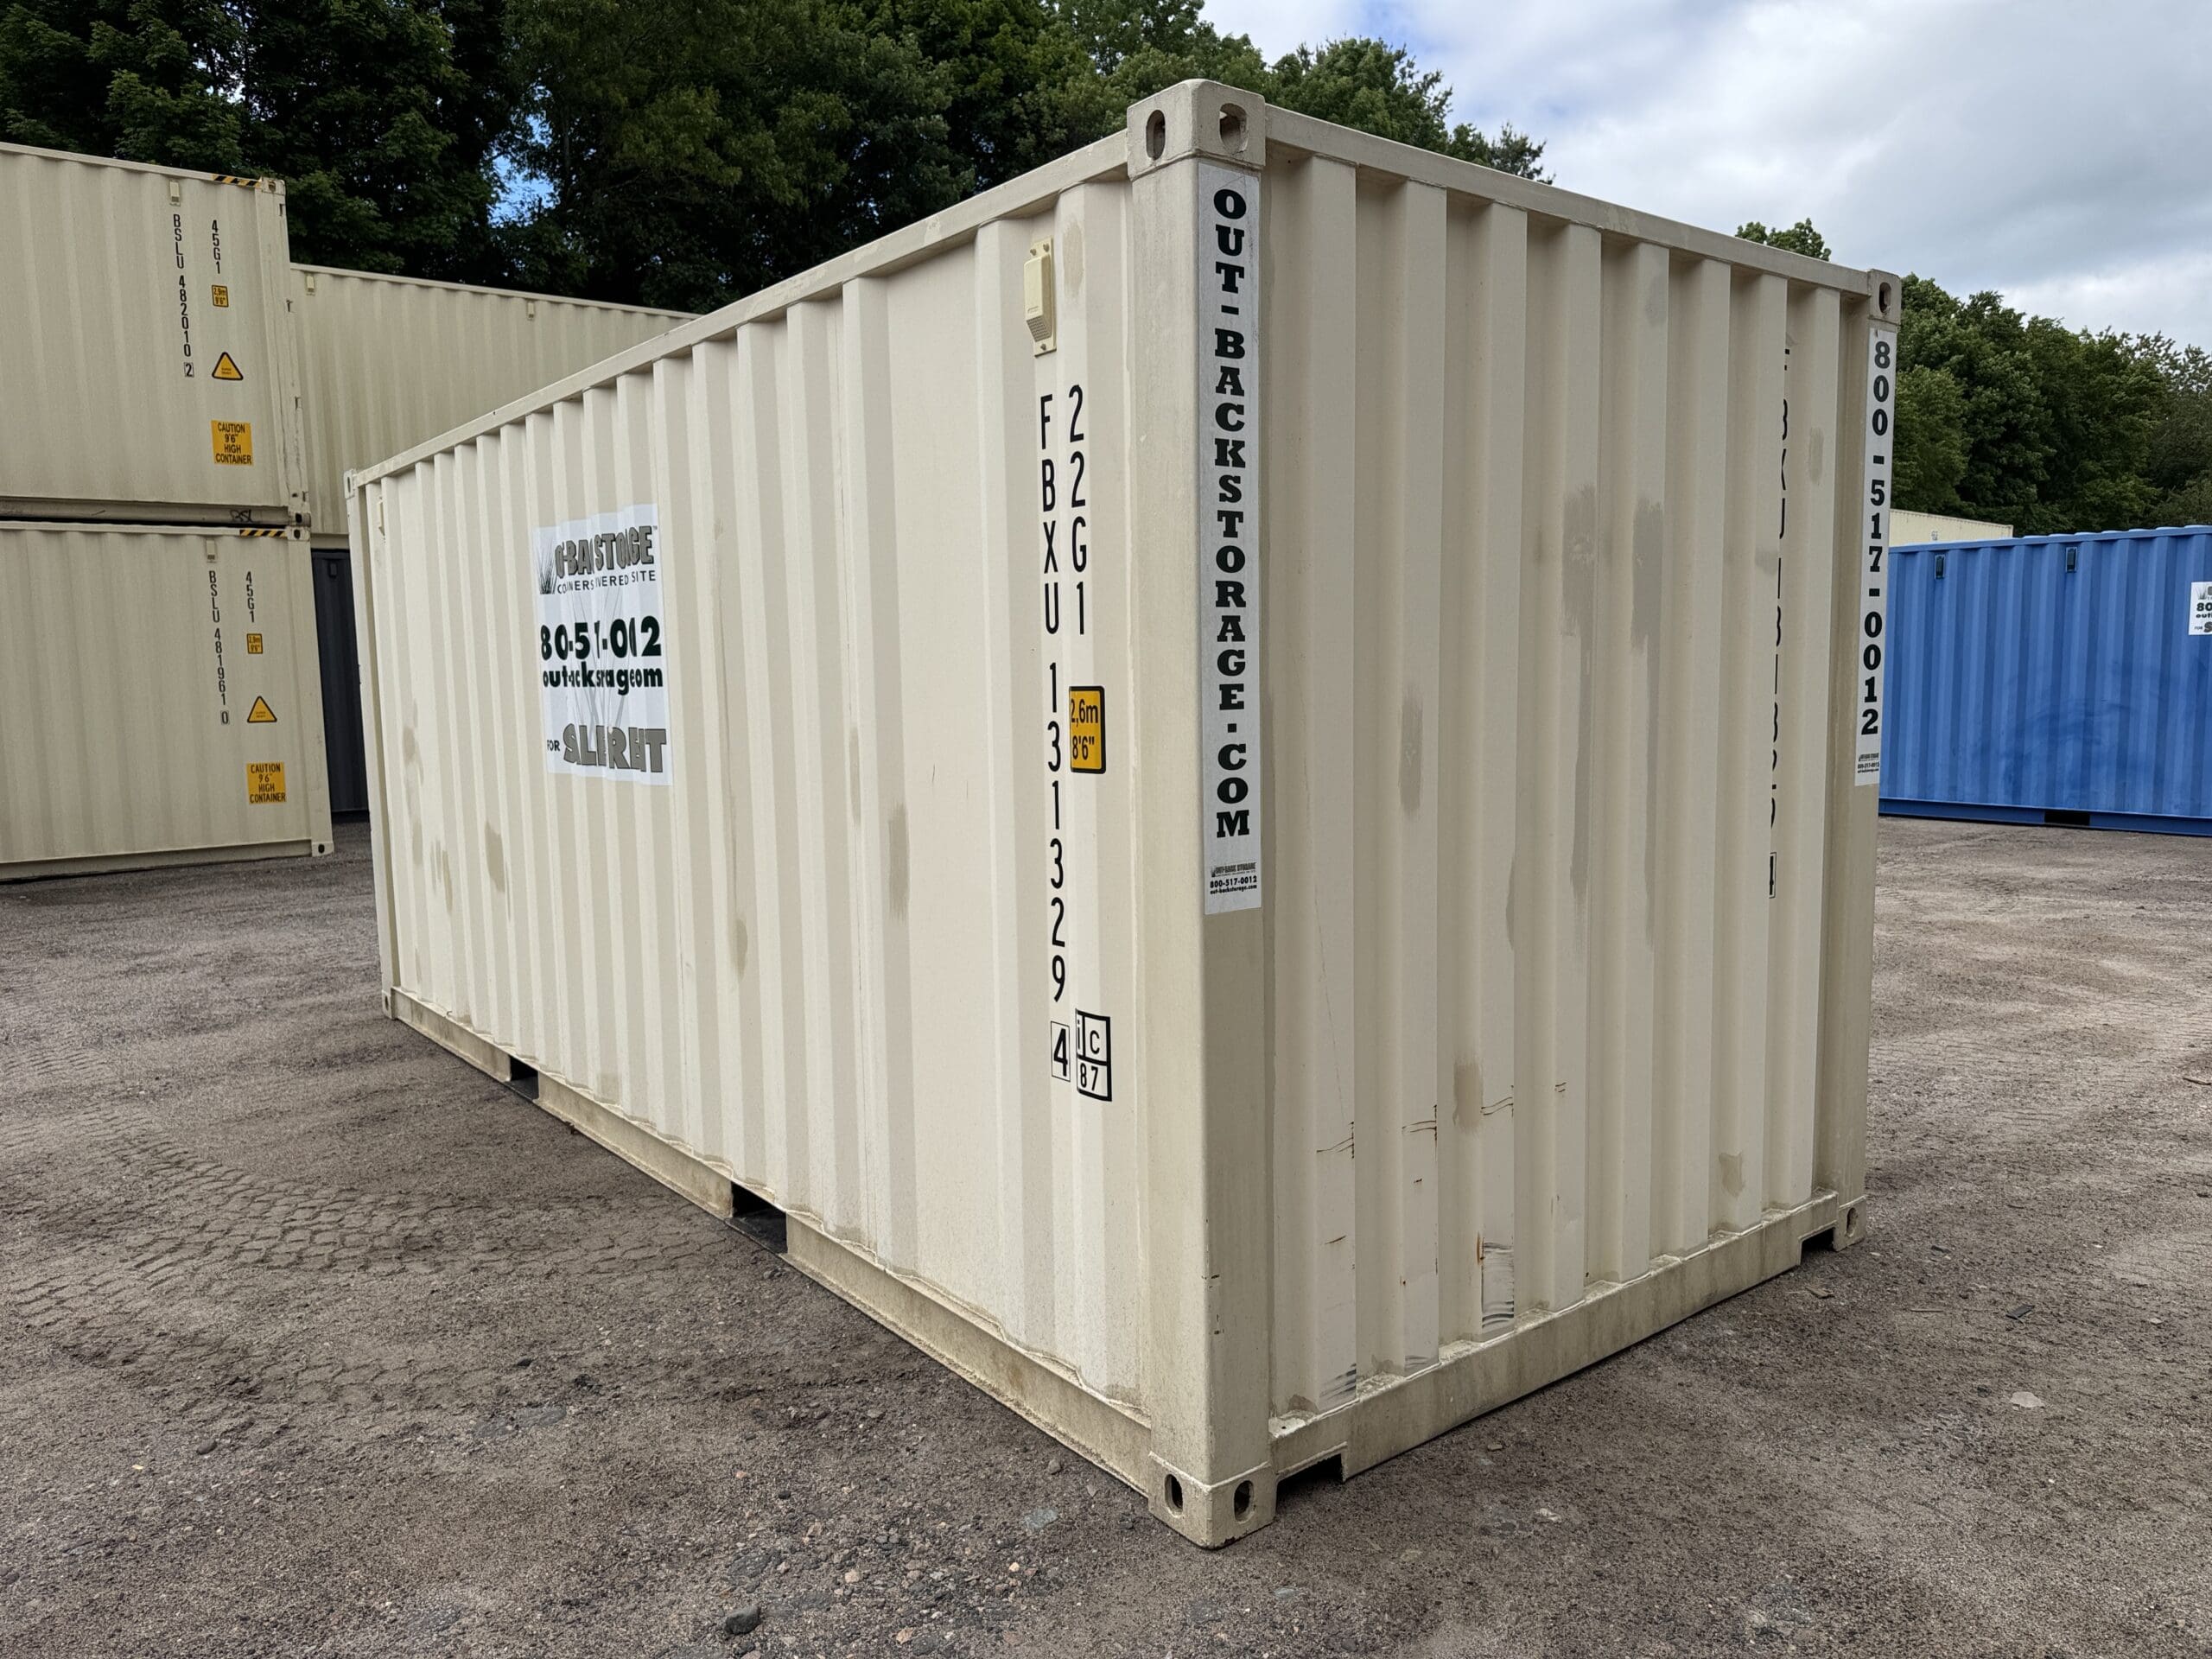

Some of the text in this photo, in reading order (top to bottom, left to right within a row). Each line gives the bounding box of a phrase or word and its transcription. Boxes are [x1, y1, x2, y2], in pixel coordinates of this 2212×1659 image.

[212, 219, 221, 274] 45G1
[174, 214, 193, 377] BSLU 482010 2
[218, 423, 245, 433] CAUTION
[215, 453, 251, 465] CONTAINER
[224, 444, 241, 454] HIGH
[1069, 385, 1087, 635] 22G1
[1860, 341, 1891, 735] 800-517-0012
[632, 570, 656, 582] SITE
[209, 570, 220, 623] BSLU
[245, 571, 255, 623] 45G1
[214, 628, 226, 706] 481961
[1071, 698, 1098, 728] 2,6m
[547, 740, 560, 752] FOR
[1040, 394, 1069, 1077] FBXU 131329 4
[1072, 735, 1095, 760] 8'6"
[251, 763, 281, 773] CAUTION
[250, 792, 286, 803] CONTAINER
[258, 783, 275, 793] HIGH
[1080, 1063, 1098, 1090] 87
